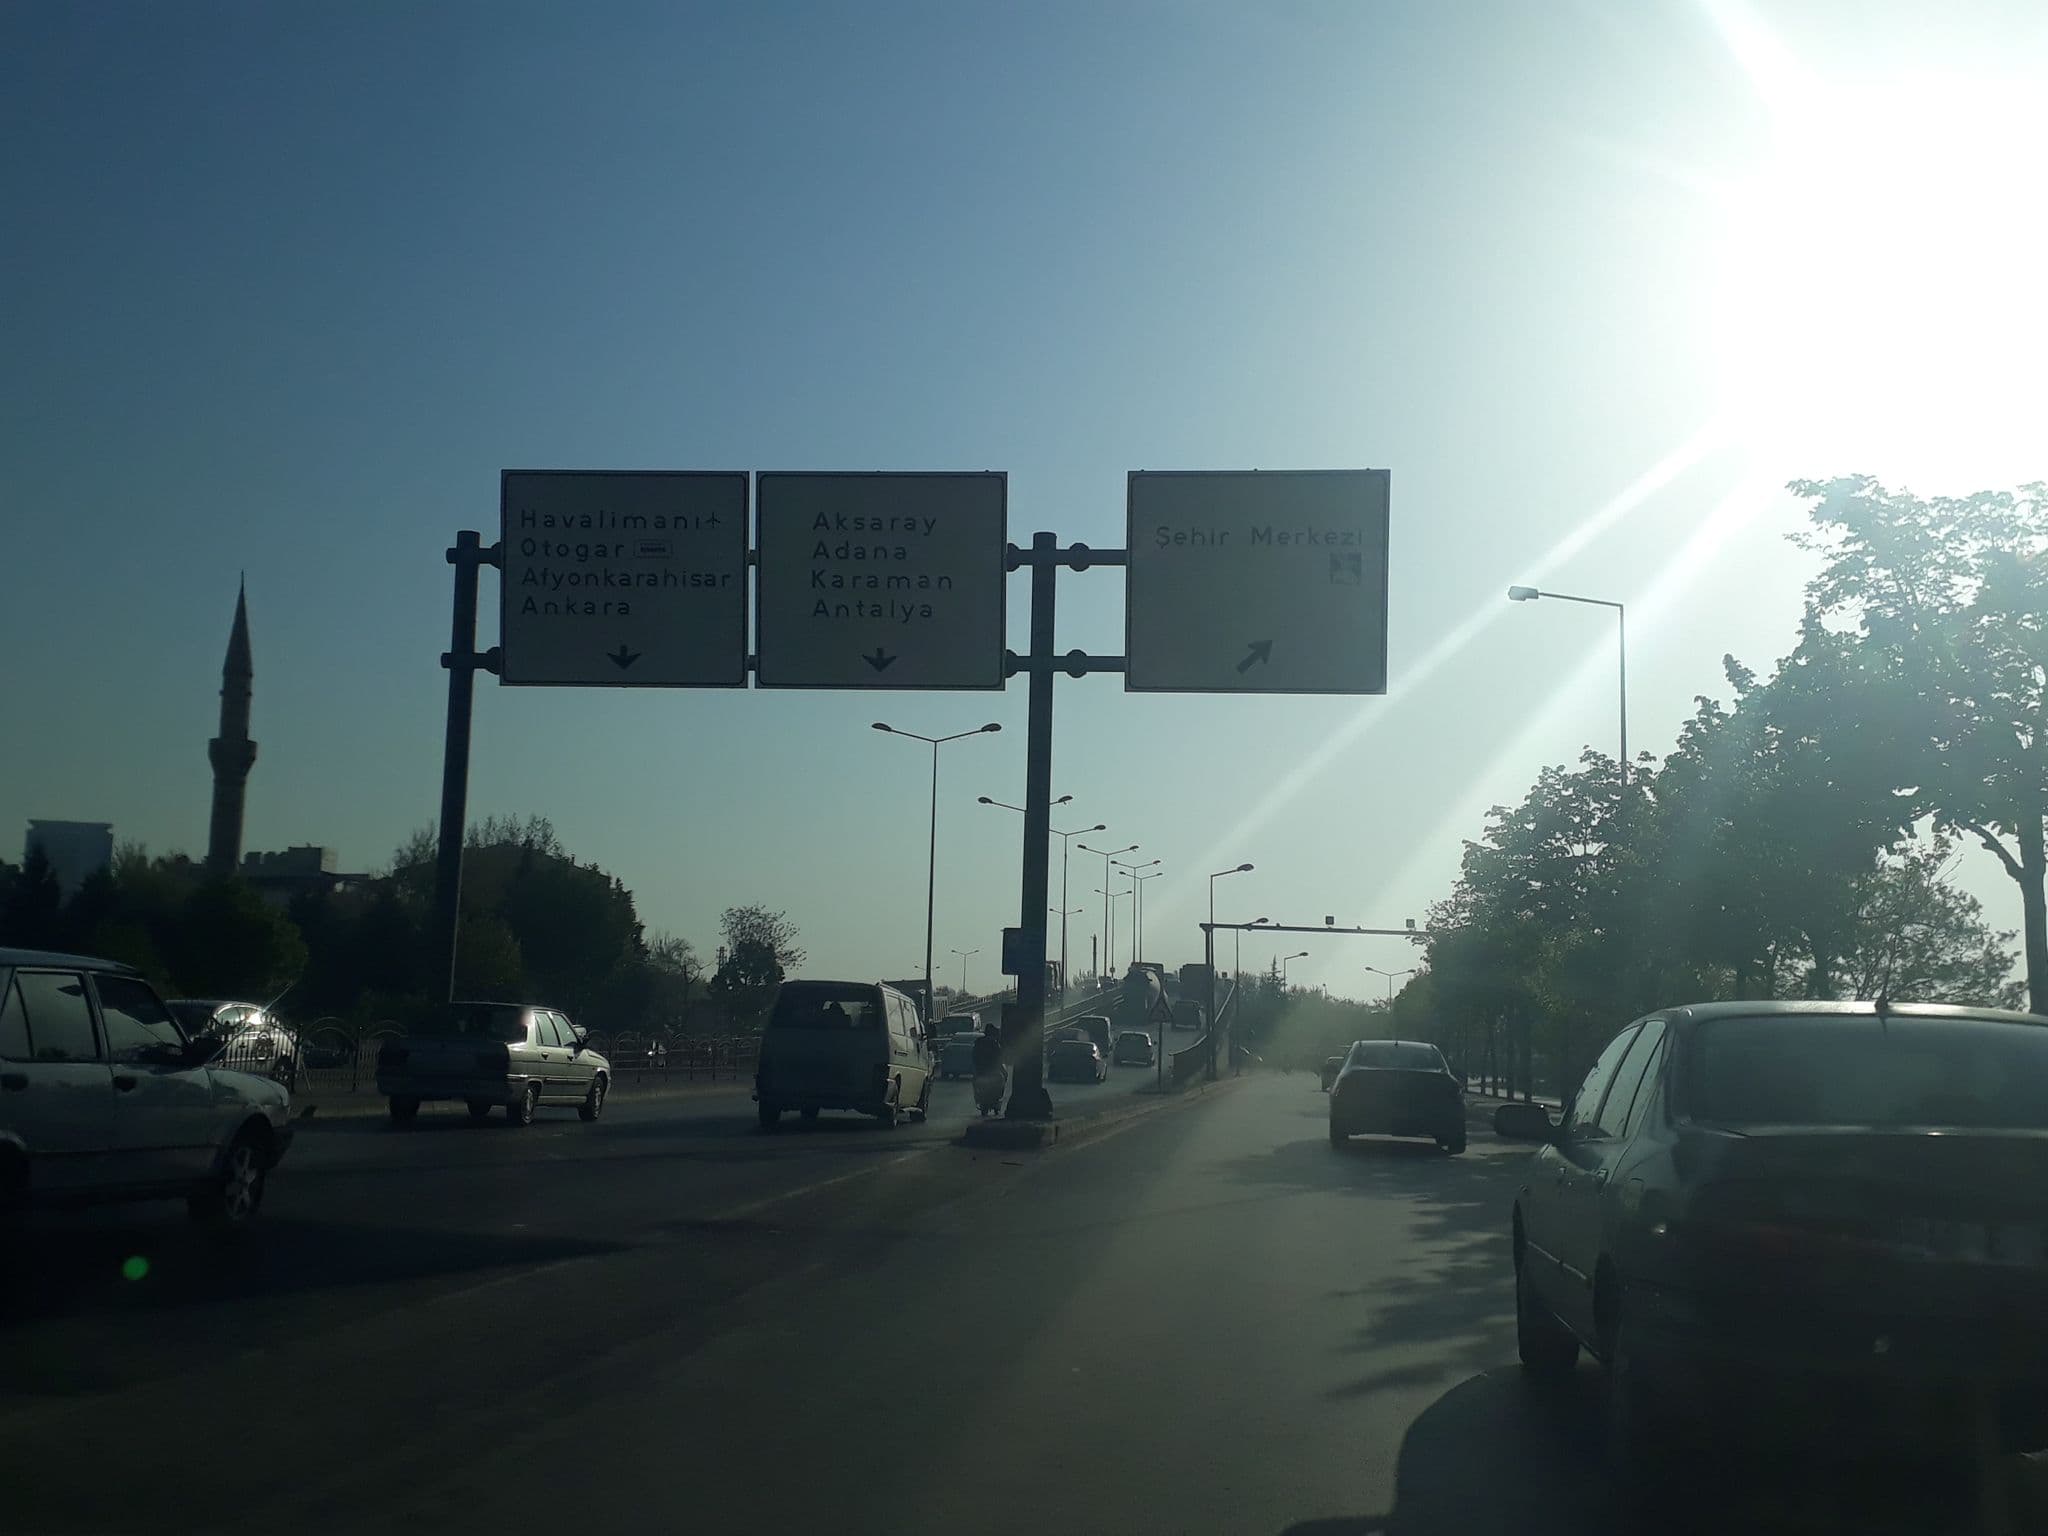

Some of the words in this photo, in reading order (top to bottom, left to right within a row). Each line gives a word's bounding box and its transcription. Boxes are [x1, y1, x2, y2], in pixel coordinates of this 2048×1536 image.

[521, 509, 700, 529] Havalimanı
[812, 511, 937, 536] Aksaray
[520, 537, 625, 562] Otogar
[812, 539, 907, 560] Adana
[1155, 525, 1231, 550] Şehir
[1251, 525, 1363, 546] Merkezi
[521, 567, 732, 591] Afyonkarahisar
[811, 569, 953, 590] Karaman
[521, 595, 631, 616] Ankara
[812, 599, 933, 624] Antalya
